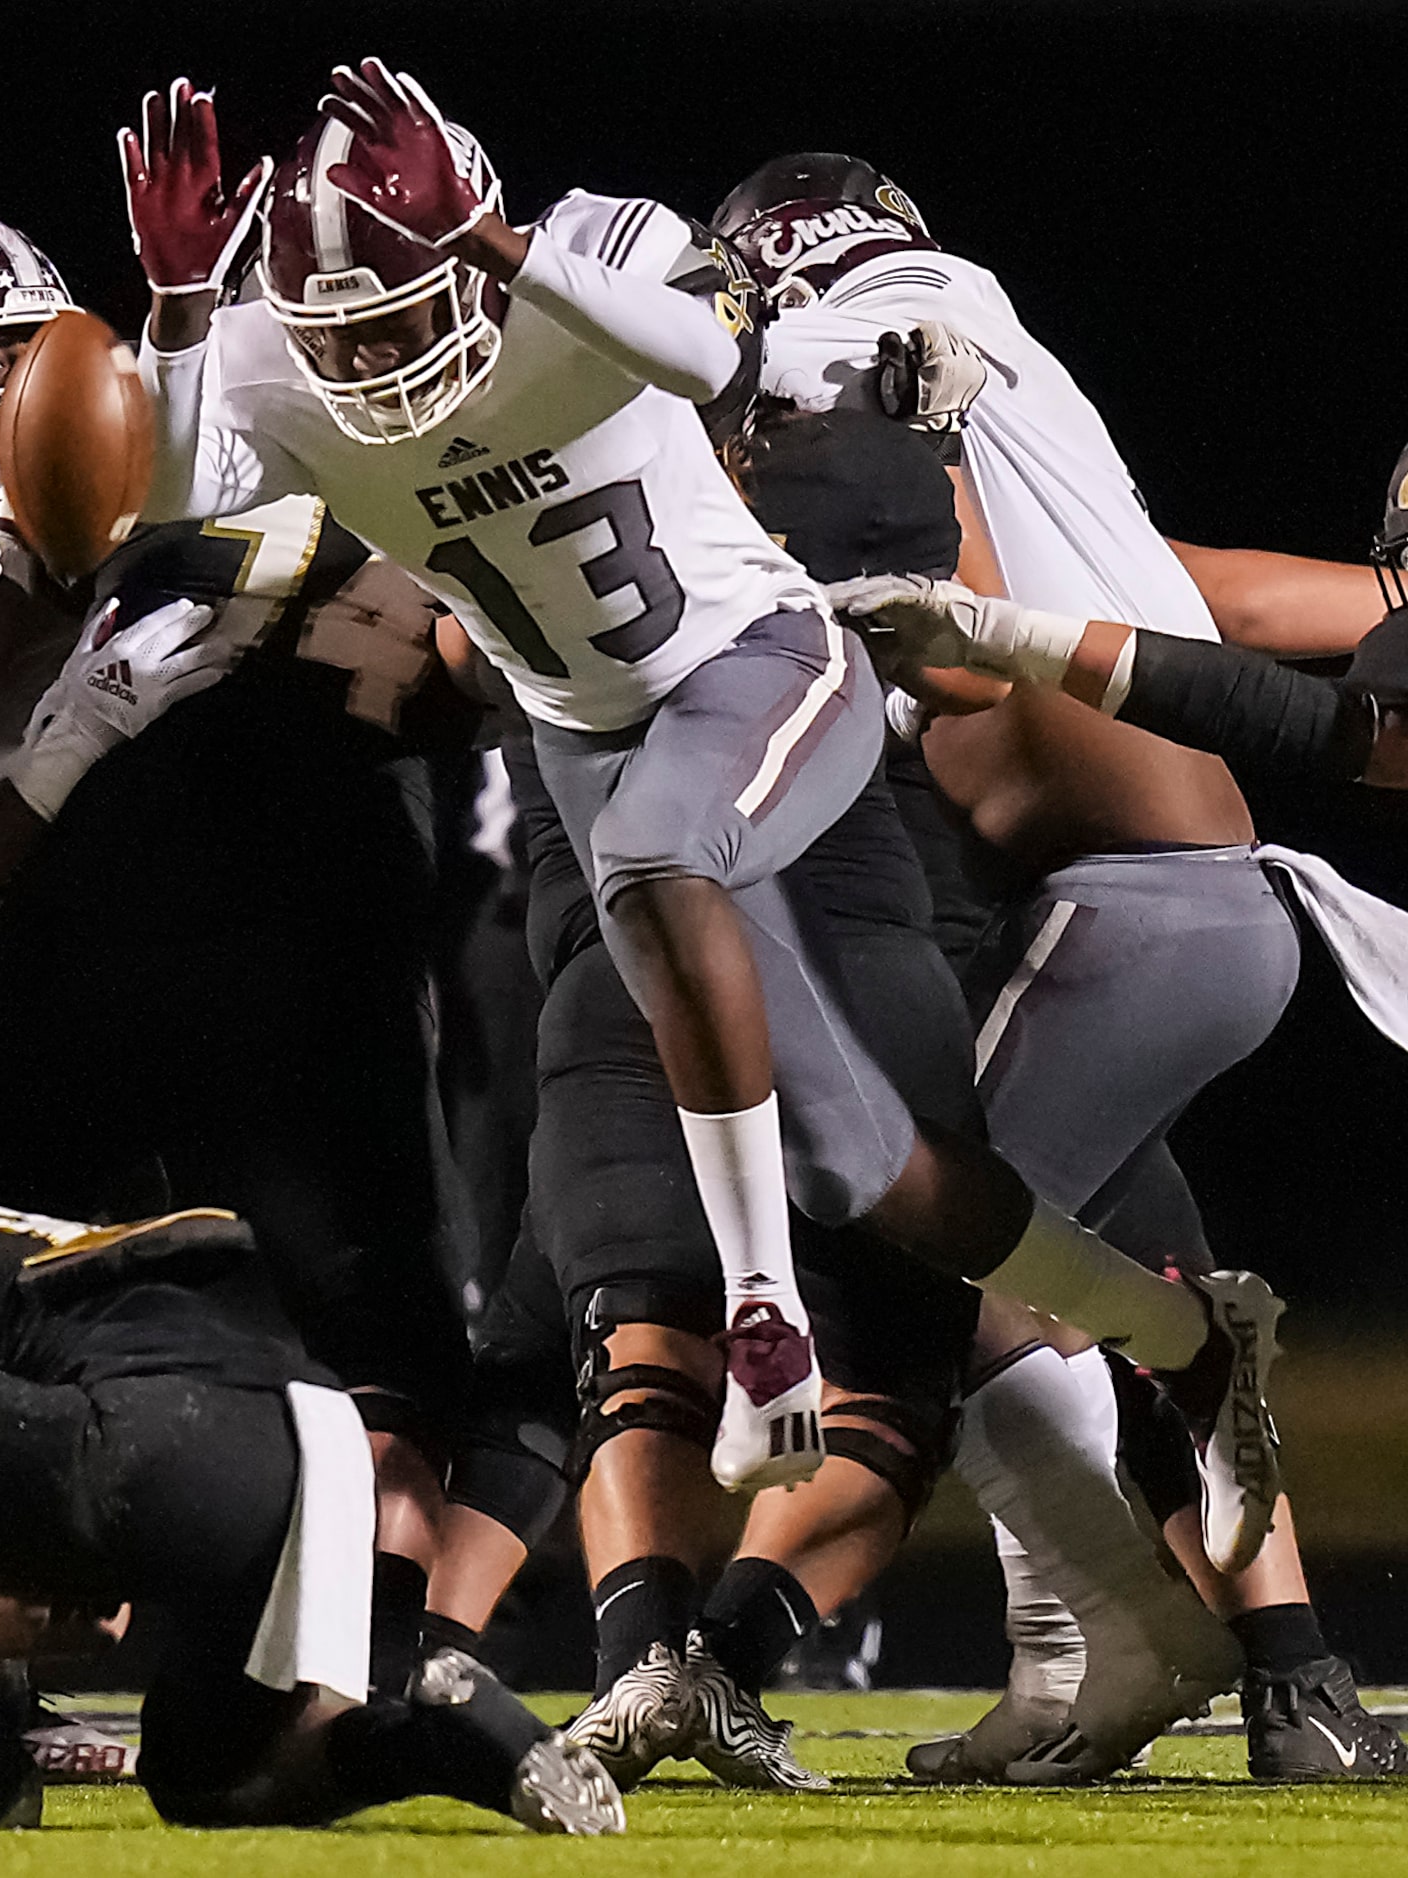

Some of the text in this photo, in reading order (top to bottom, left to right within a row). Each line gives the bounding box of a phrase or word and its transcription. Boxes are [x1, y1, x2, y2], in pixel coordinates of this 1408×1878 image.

[415, 449, 570, 529] ENNIS
[425, 480, 686, 679] 13
[87, 675, 139, 706] adidas
